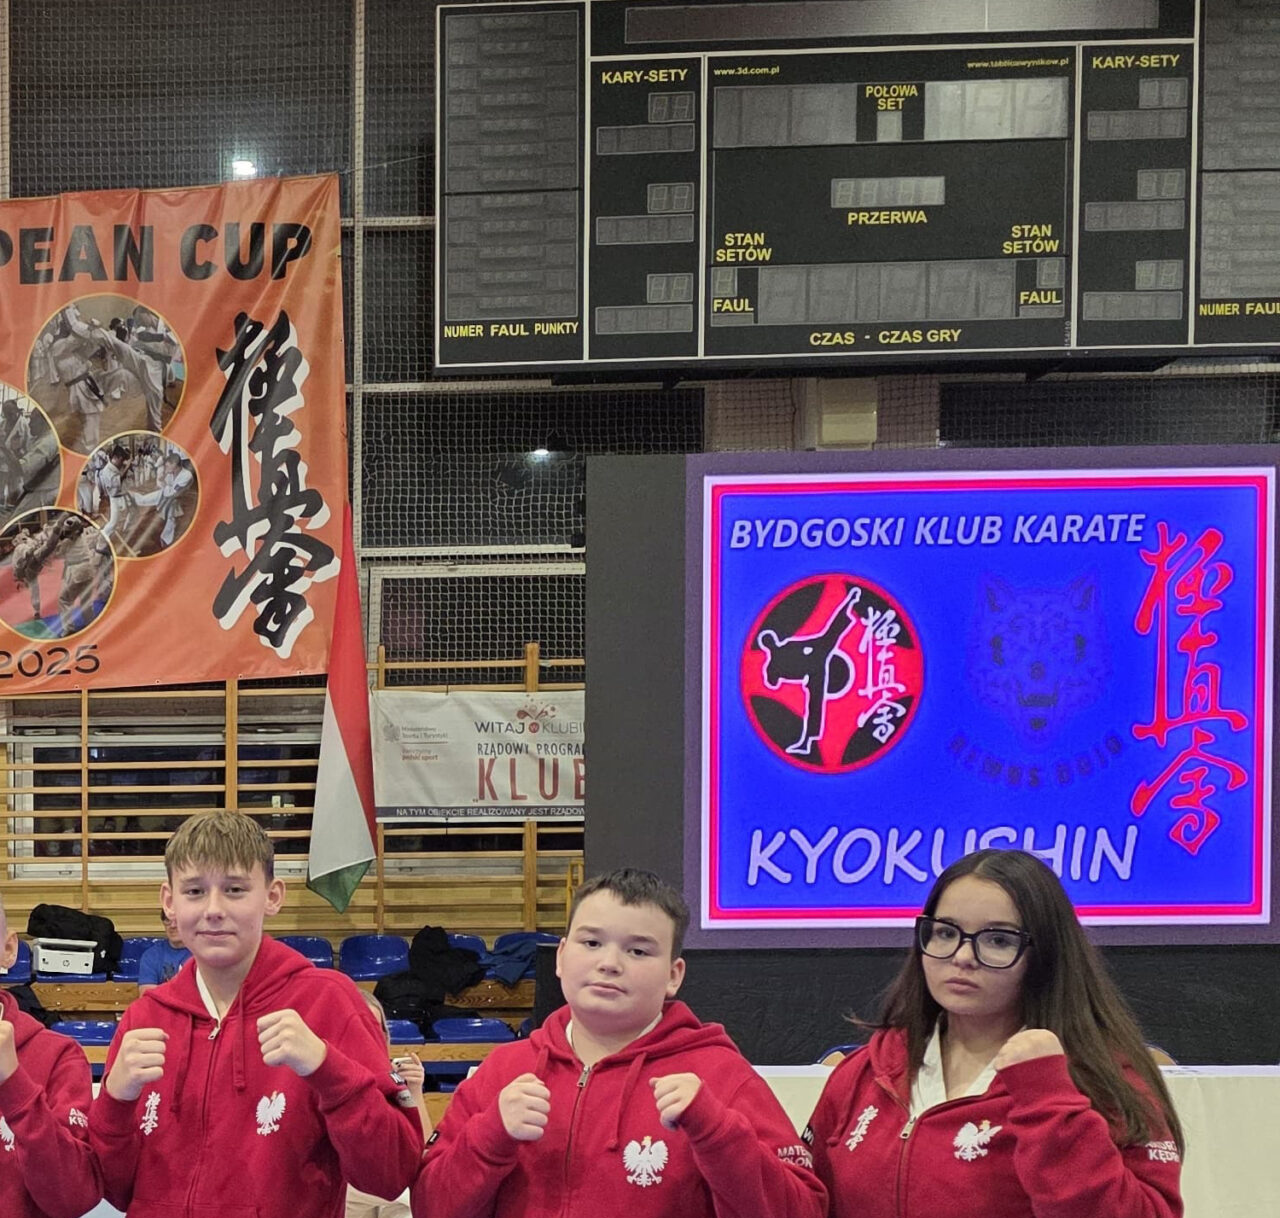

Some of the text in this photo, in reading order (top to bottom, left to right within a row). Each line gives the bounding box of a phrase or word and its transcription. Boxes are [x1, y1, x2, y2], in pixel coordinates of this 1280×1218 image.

[1092, 54, 1179, 69] KARY-SETY
[601, 68, 688, 84] KARY-SETY
[713, 65, 780, 76] www.3d.com.pl
[865, 85, 918, 98] POŁOWA
[877, 98, 905, 111] SET
[847, 210, 927, 225] PRZERWA
[1011, 224, 1052, 238] STAN
[724, 233, 765, 246] STAN
[1002, 237, 1059, 254] SETÓW
[179, 221, 313, 282] CUP
[715, 245, 772, 262] SETÓW
[1019, 291, 1062, 304] FAUL
[712, 299, 754, 313] FAUL
[1199, 303, 1240, 316] NUMER
[443, 321, 578, 338] NUMER FAUL PUNKTY
[809, 331, 855, 346] CZAS
[878, 329, 923, 344] CZAS
[926, 328, 961, 343] GRY
[730, 513, 1146, 550] BYDGOSKI KLUB KARATE
[474, 721, 525, 734] WITAJ
[542, 720, 585, 734] KLUBI
[477, 742, 585, 759] RZĄDOWY PROGRA
[527, 807, 549, 816] JEST
